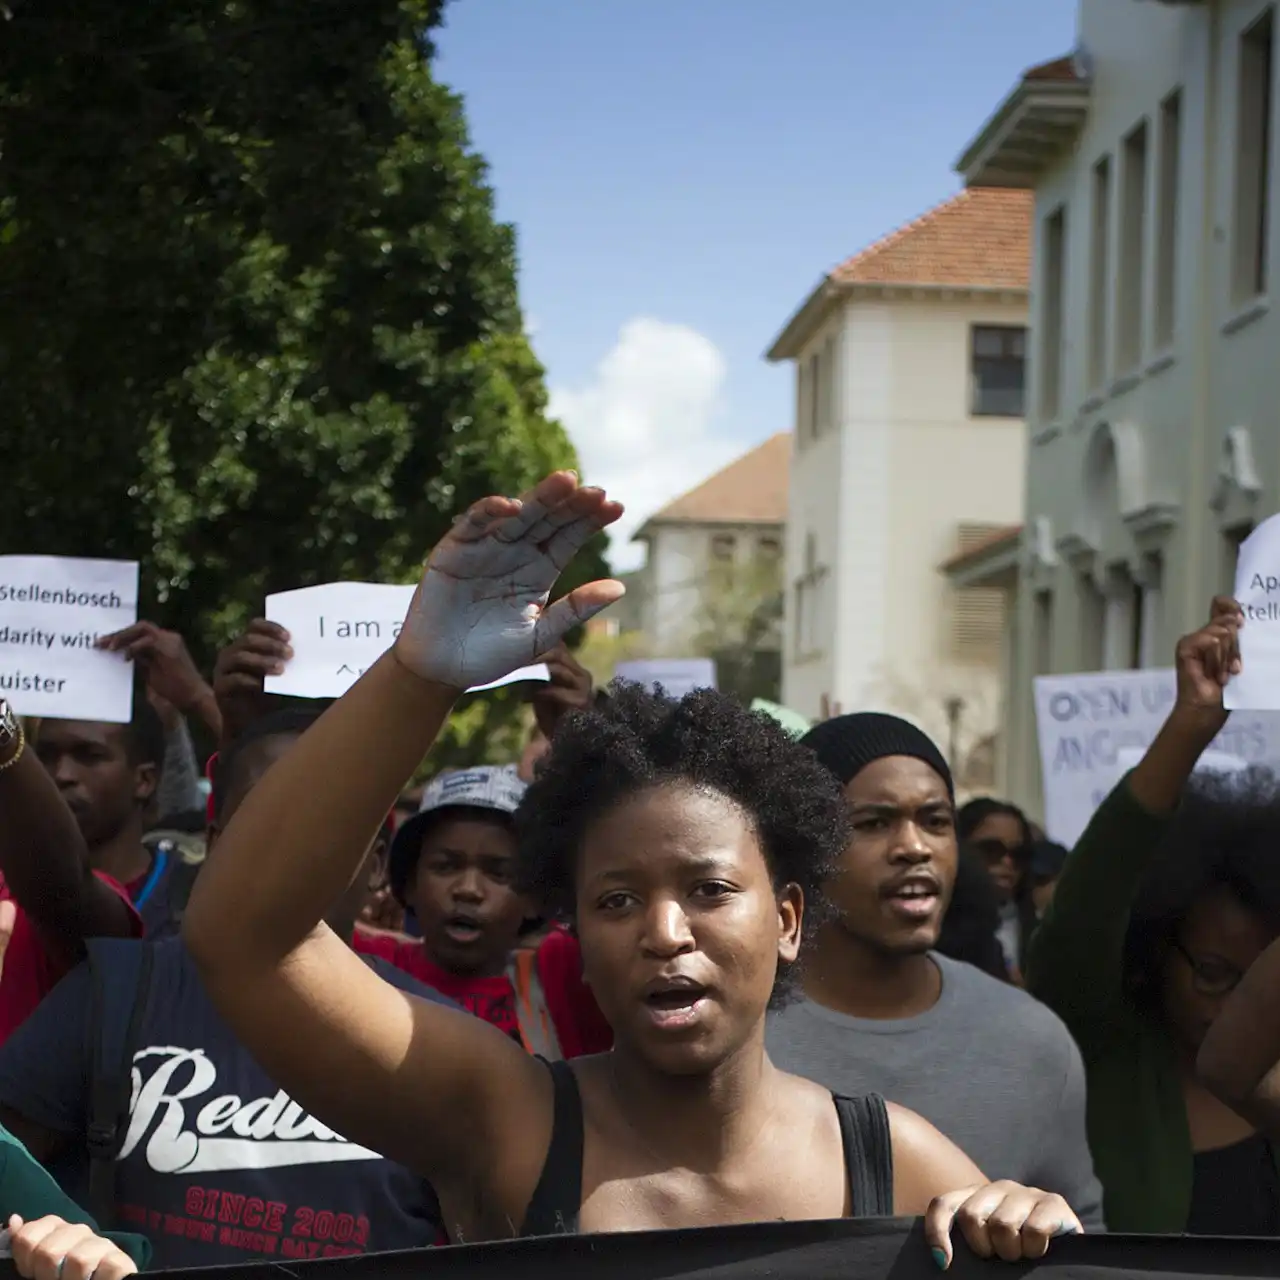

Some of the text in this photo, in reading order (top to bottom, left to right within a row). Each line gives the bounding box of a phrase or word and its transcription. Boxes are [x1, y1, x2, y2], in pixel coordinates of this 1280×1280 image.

[319, 615, 325, 638] I
[335, 619, 381, 639] am
[185, 1186, 287, 1233] SINCE
